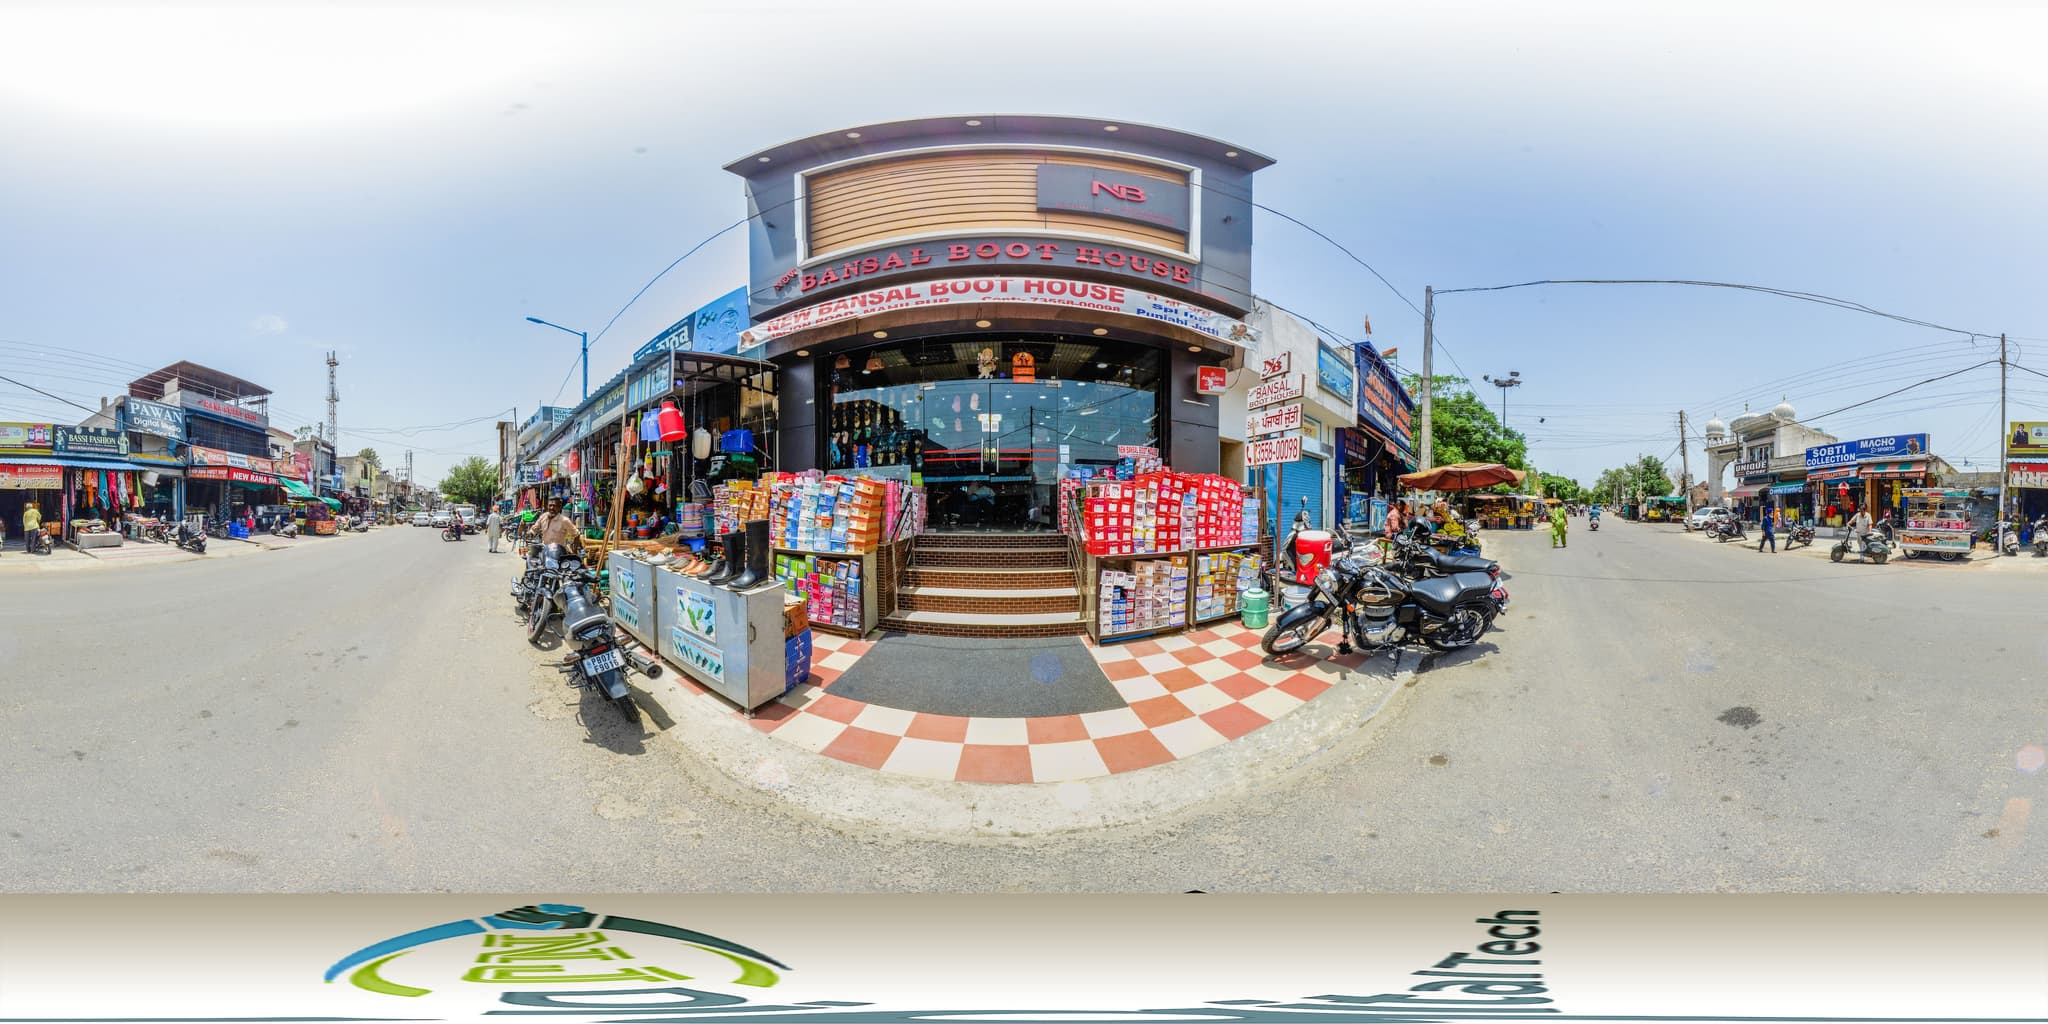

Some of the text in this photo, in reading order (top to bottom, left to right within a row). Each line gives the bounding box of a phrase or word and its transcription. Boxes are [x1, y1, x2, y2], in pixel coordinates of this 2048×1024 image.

[1091, 179, 1147, 203] NB
[801, 248, 932, 293] BANSAL
[947, 243, 1059, 261] BOOT
[1076, 246, 1192, 284] HOUSE
[767, 279, 1125, 332] NEW BANSAL BOOT HOUSE
[1256, 379, 1291, 399] BANSAL
[1248, 397, 1268, 408] BOOT
[1270, 388, 1300, 402] HOUSE
[130, 401, 184, 424] PAWAN
[133, 417, 160, 428] Digital
[68, 433, 116, 445] BASSI FASHION
[1860, 437, 1895, 449] MACHO
[1254, 438, 1298, 462] 3558-00098
[1813, 445, 1846, 458] SOBTI
[1735, 460, 1767, 472] UNIQUE
[1806, 453, 1856, 466] COLLECTION
[233, 471, 248, 481] NEW
[250, 474, 267, 484] RANA
